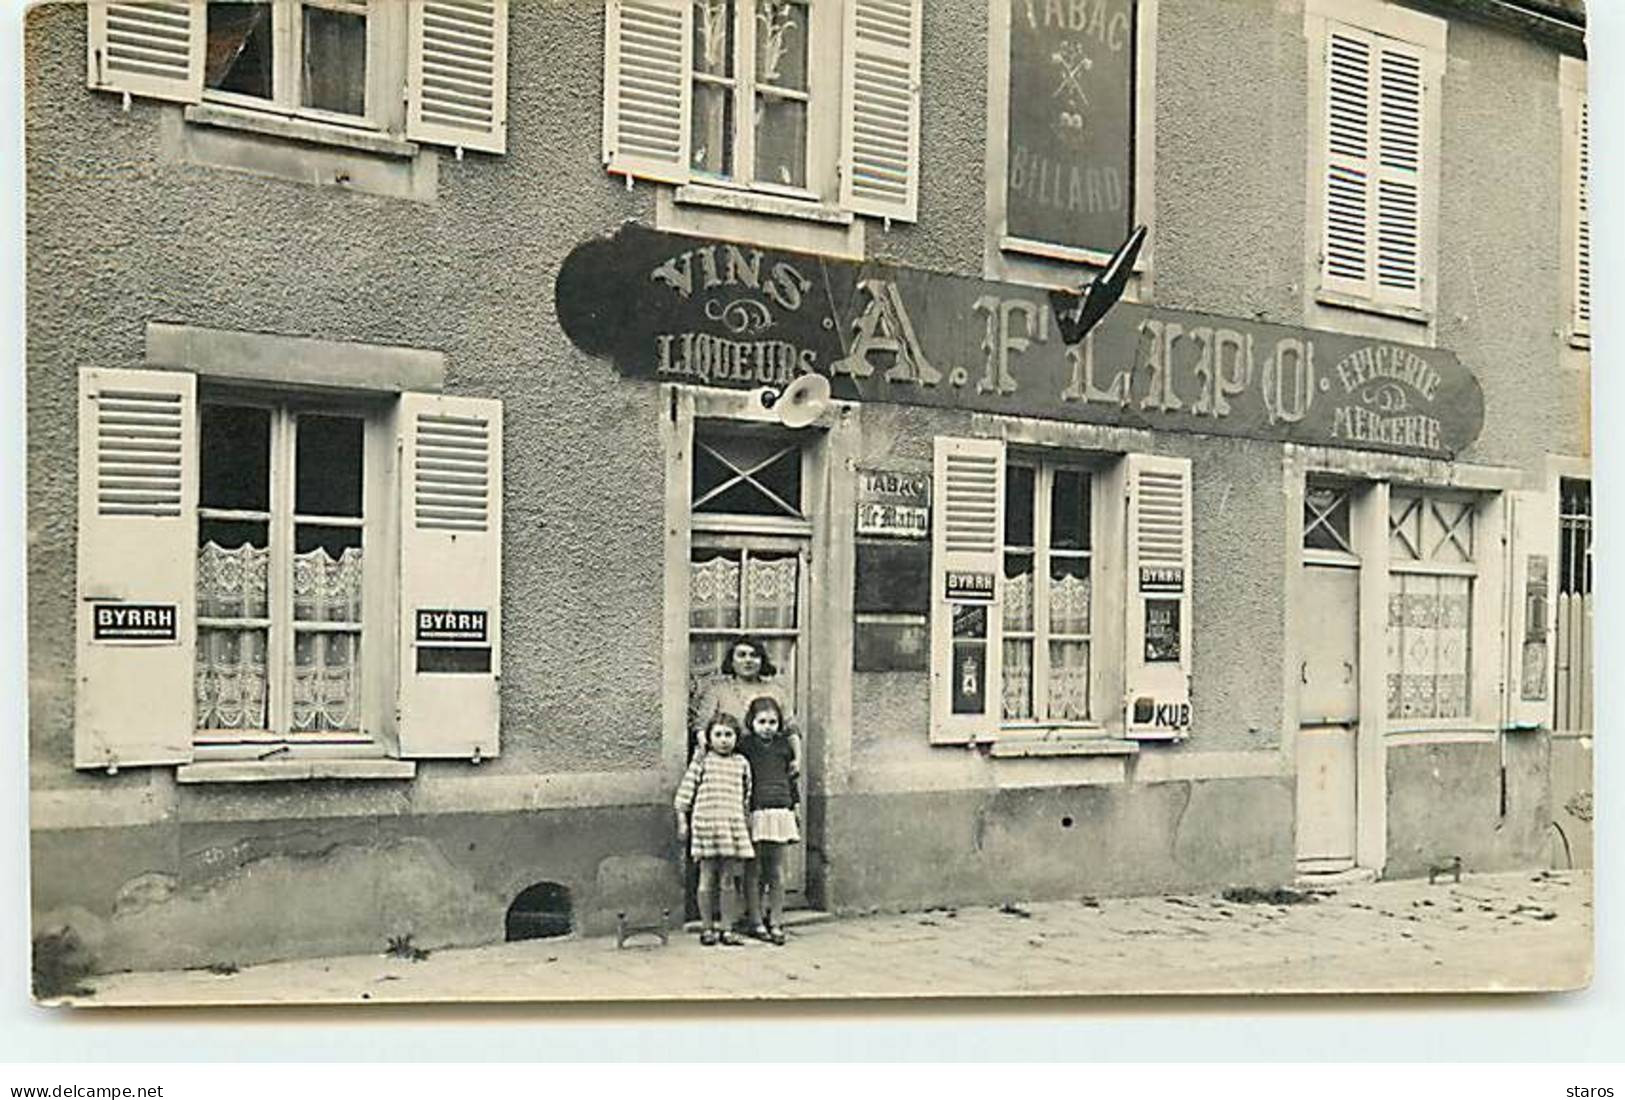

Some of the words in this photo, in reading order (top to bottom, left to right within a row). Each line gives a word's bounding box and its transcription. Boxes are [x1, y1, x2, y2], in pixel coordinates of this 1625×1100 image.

[1010, 149, 1122, 213] BILLARD
[650, 244, 812, 312] VINS
[656, 332, 817, 387] LIQUEURS
[972, 294, 1316, 425] FLIPO
[1336, 345, 1442, 402] EPICERIE
[1330, 405, 1442, 450] MERCERIE
[864, 474, 924, 496] TABAC
[949, 573, 993, 590] BYRRH
[1141, 568, 1182, 583] BYRRH
[98, 608, 173, 627] BYRRH
[419, 612, 484, 630] BYRRH
[1155, 703, 1191, 728] KUB
